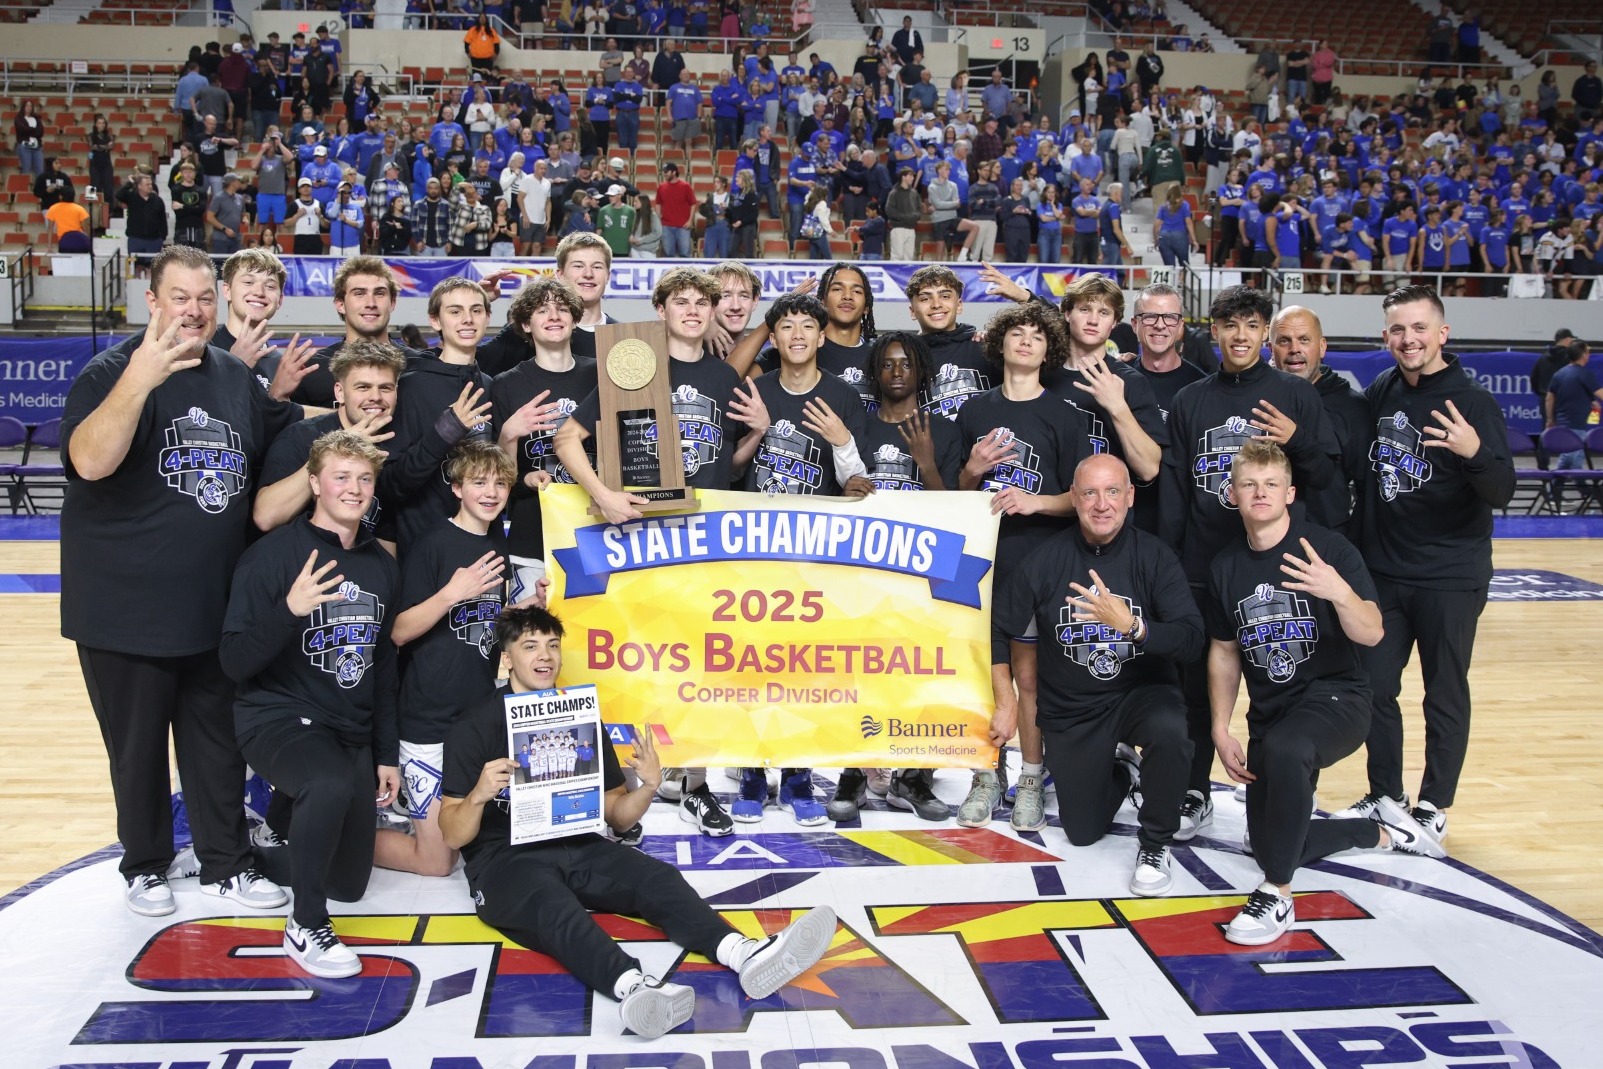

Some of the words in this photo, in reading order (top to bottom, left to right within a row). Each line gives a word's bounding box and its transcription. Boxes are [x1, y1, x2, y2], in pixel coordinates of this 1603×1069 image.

[1012, 38, 1030, 51] 13
[306, 268, 333, 284] AI
[1153, 271, 1169, 284] 214
[1286, 278, 1301, 290] 215
[165, 448, 244, 474] 4-PEAT
[603, 515, 708, 569] STATE
[720, 511, 938, 573] CHAMPIONS
[712, 589, 824, 623] 2025
[1241, 620, 1315, 647] 4-PEAT
[587, 629, 691, 672] BOYS
[704, 632, 957, 676] BASKETBALL
[677, 682, 759, 703] COPPER
[766, 683, 858, 704] DIVISION
[511, 703, 545, 719] STATE
[547, 696, 596, 715] CHAMPS!
[887, 718, 968, 738] Banner
[889, 744, 926, 757] Sports
[928, 744, 977, 756] Medicine
[676, 839, 789, 865] IA
[70, 889, 1477, 1045] STATE
